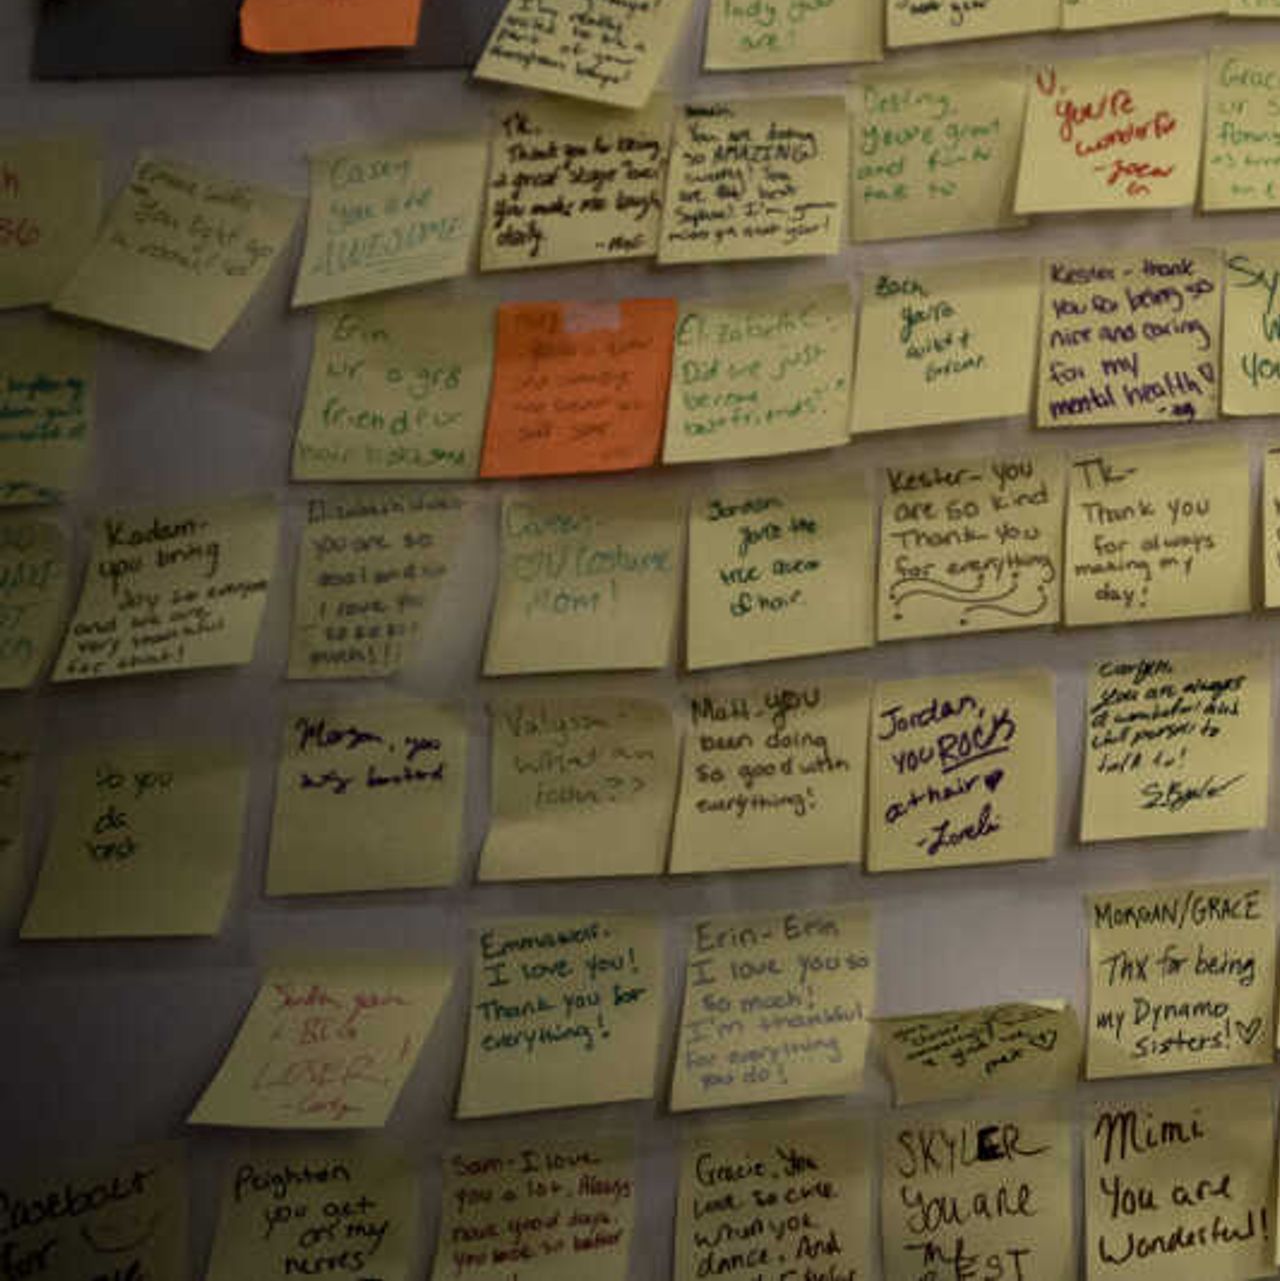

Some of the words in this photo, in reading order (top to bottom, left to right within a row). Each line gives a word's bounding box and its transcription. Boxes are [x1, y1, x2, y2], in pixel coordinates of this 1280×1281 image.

[1050, 388, 1115, 419] mental
[1081, 499, 1159, 525] Thank
[1197, 943, 1256, 988] being
[1096, 1010, 1125, 1040] my
[1132, 996, 1230, 1025] Dynamo
[1093, 1109, 1207, 1164] Mimi
[1171, 1174, 1232, 1207] are
